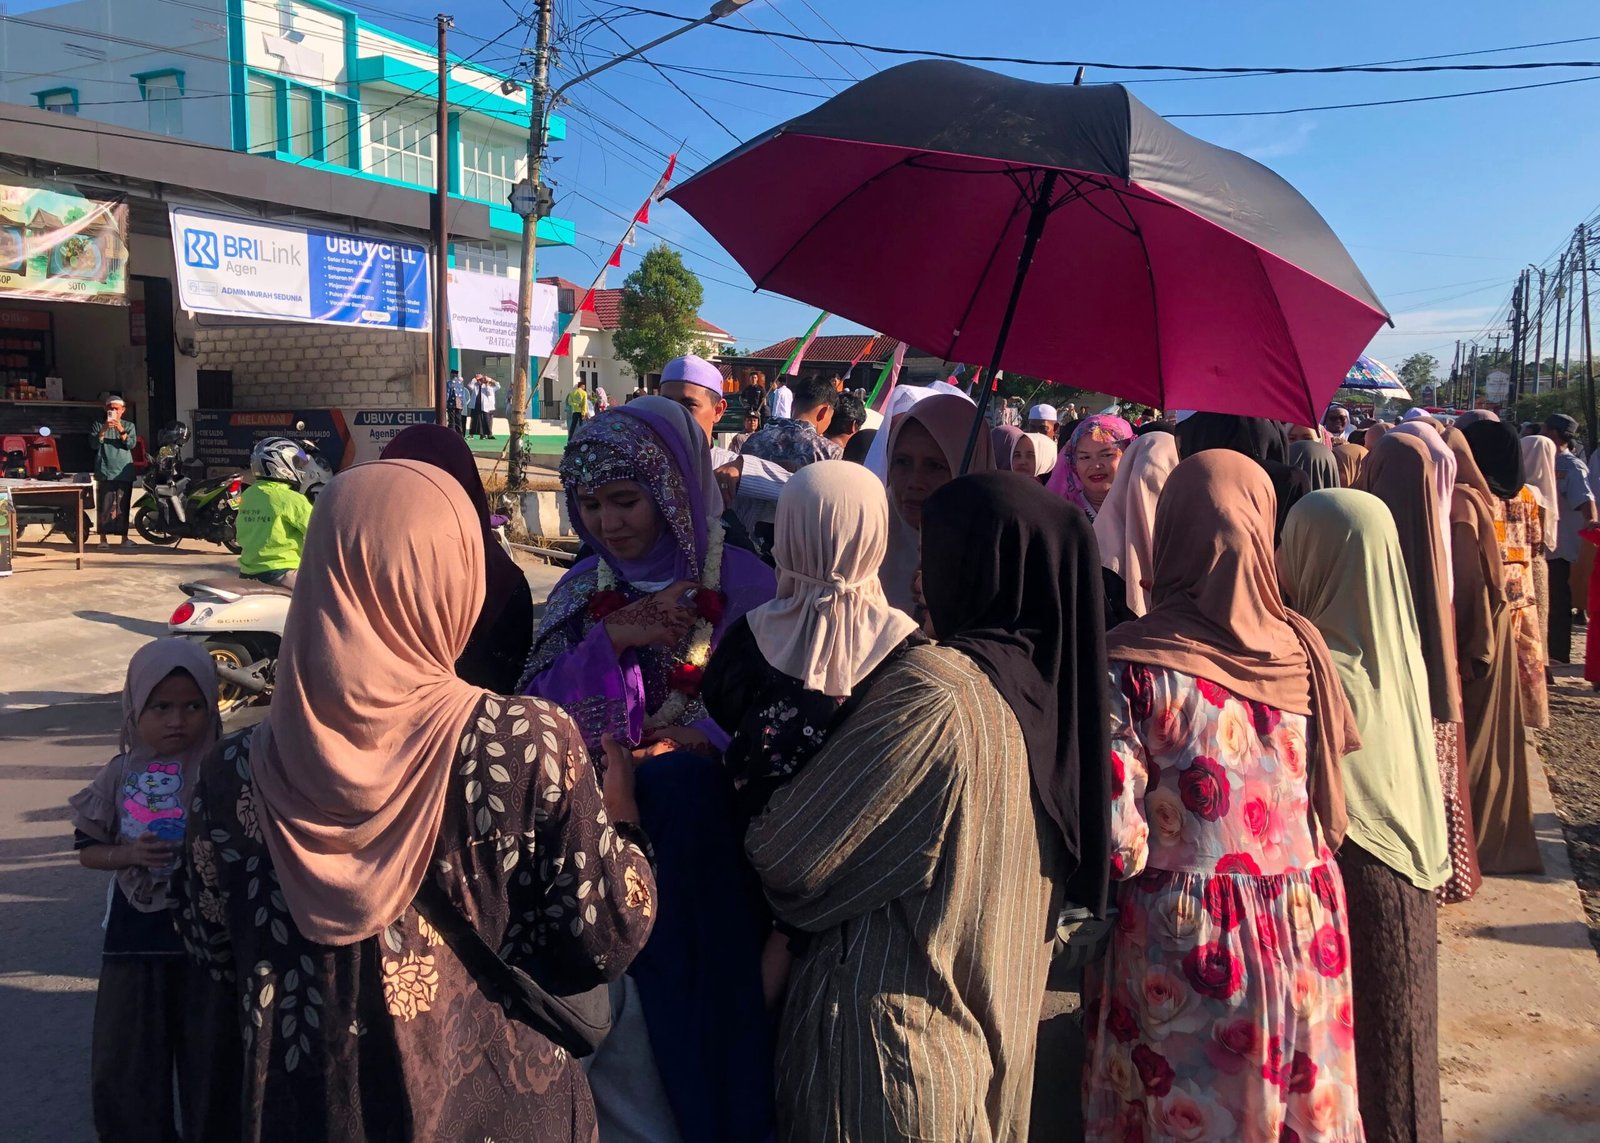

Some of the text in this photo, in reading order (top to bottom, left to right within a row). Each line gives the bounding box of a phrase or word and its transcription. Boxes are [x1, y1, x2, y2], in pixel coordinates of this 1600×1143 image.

[224, 235, 301, 266] BRILink
[326, 235, 416, 264] UBUY CELL
[226, 260, 257, 276] Agen
[0, 275, 11, 284] OP
[68, 281, 86, 291] SOTO
[221, 287, 246, 296] ADMIN
[247, 290, 273, 299] MURAH
[274, 294, 302, 302] SEDUNIA
[452, 313, 492, 326] Penyambutan
[492, 318, 518, 330] Kedatang
[478, 324, 507, 336] Kecamatan
[238, 414, 286, 425] MELAYANI
[363, 413, 426, 424] UBUY CELL
